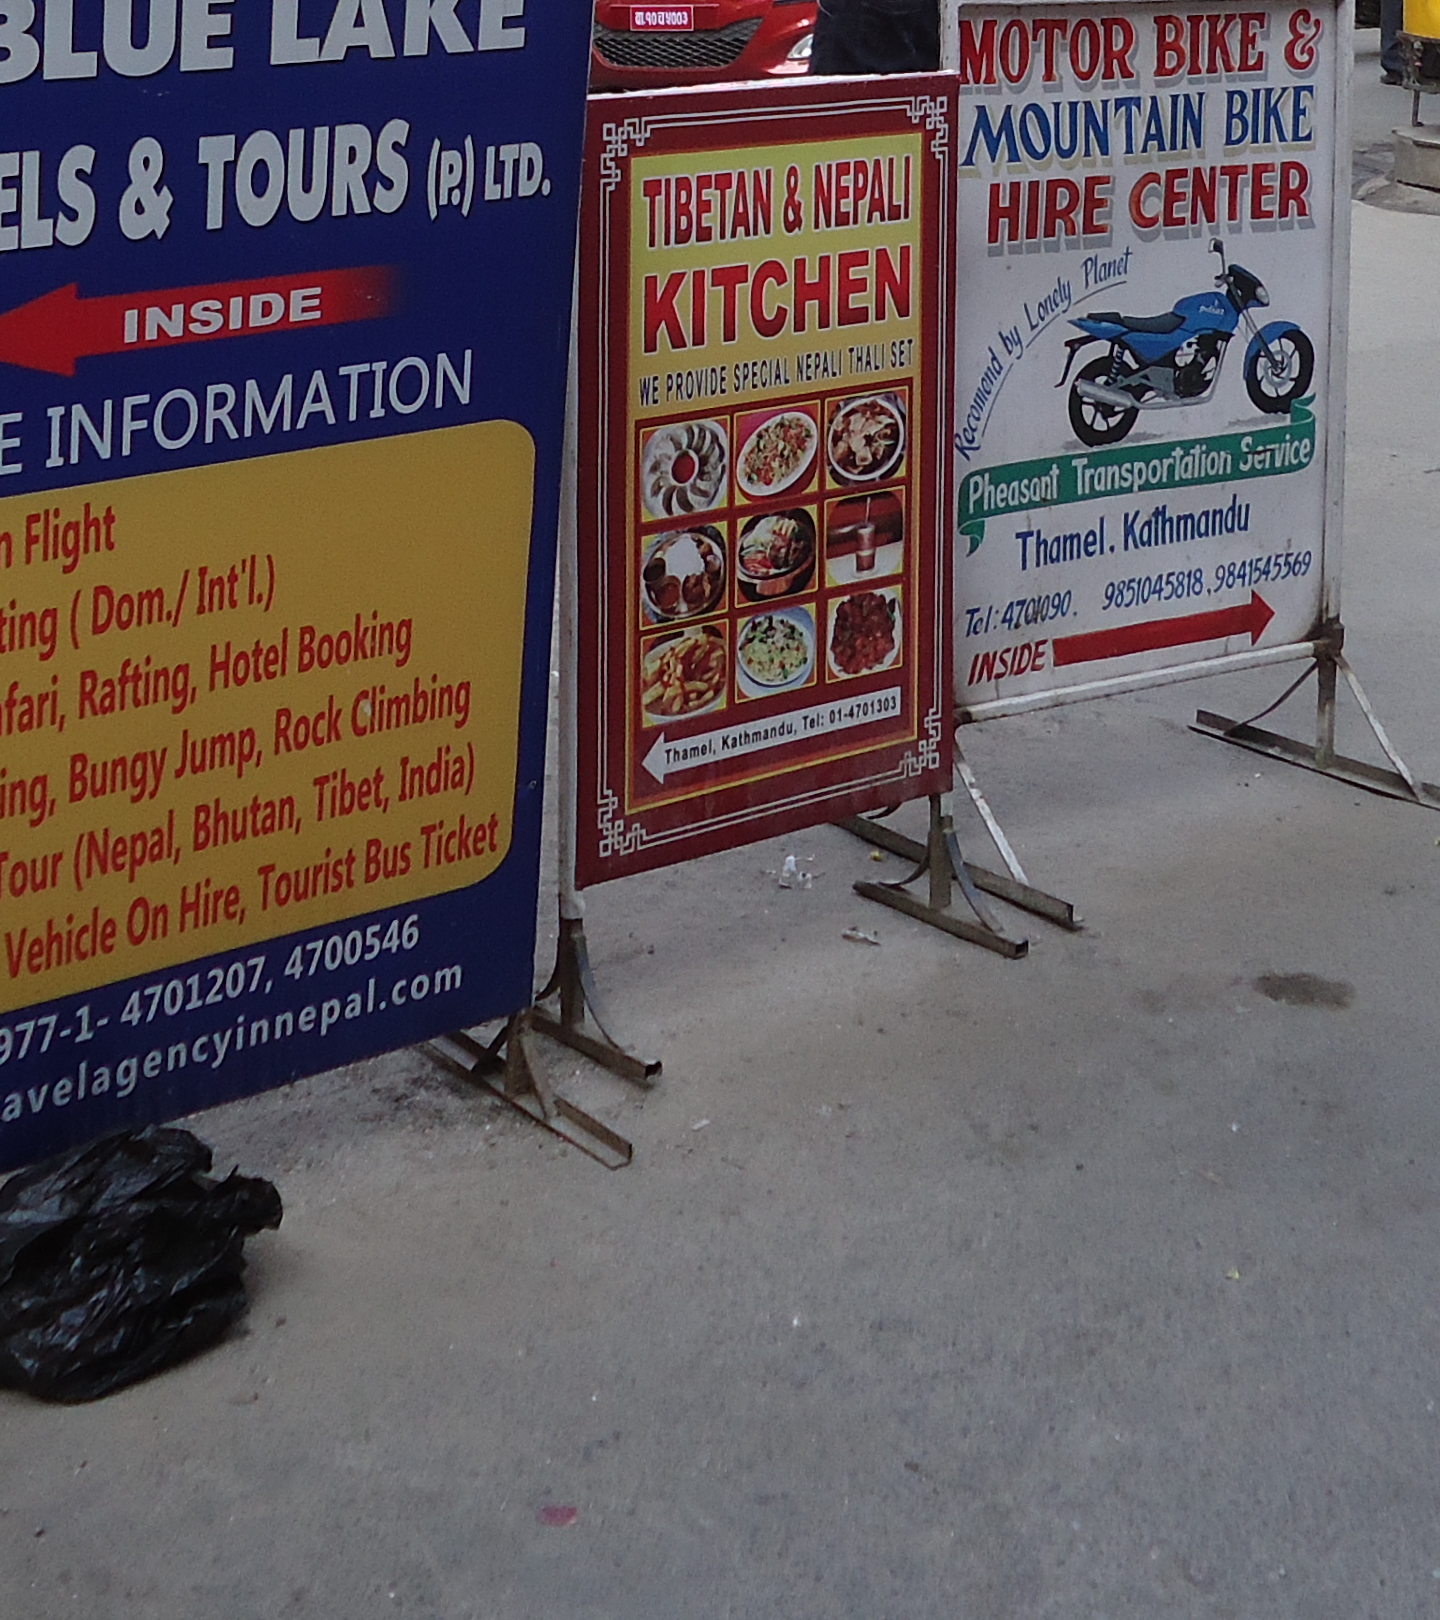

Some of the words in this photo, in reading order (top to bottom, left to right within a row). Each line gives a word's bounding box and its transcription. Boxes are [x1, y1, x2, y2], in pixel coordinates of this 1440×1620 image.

[960, 16, 1135, 85] MOTOR
[1153, 12, 1266, 77] BIKE
[1284, 8, 1323, 71] &
[959, 92, 1207, 167] MOUNTAIN
[1224, 85, 1315, 147] BIKE
[118, 135, 174, 241] &
[197, 118, 410, 231] TOURS
[484, 141, 551, 203] LTD.
[642, 167, 773, 250] TIBETAN
[782, 164, 803, 235] &
[813, 154, 912, 231] NEPALI
[988, 175, 1111, 245] HIRE
[1128, 161, 1309, 229] CENTER
[122, 285, 323, 345] INSIDE
[642, 244, 912, 355] KITCHEN
[998, 326, 1024, 360] by
[1023, 276, 1072, 331] Lonely
[1081, 246, 1133, 289] Planet
[46, 349, 474, 468] INFORMATION
[639, 375, 660, 407] WE
[666, 365, 727, 402] PROVIDE
[733, 356, 791, 392] SPECIAL
[796, 347, 843, 380] NEPALI
[848, 343, 885, 373] THALI
[890, 338, 914, 368] SET
[968, 465, 1060, 515] Pheasant
[1071, 446, 1232, 492] Transportation
[1239, 433, 1312, 472] Service
[24, 503, 116, 574] Flight
[1123, 493, 1251, 552] Kathmandu
[77, 654, 197, 723] Rafting,
[208, 627, 289, 692] Hotel
[297, 610, 414, 676] Booking
[968, 638, 1048, 686] INSIDE
[68, 744, 167, 807] Bungy
[174, 717, 262, 780] Jump,
[274, 696, 342, 759] Rock
[350, 672, 472, 738] Climbing
[665, 738, 717, 765] Thamel,
[721, 720, 798, 751] Kathmandu,
[802, 712, 826, 731] Tel:
[828, 695, 898, 726] 01-4701303
[72, 813, 182, 895] (Nepal,
[191, 788, 303, 853] Bhutan,
[313, 764, 392, 826] Tibet,
[397, 742, 475, 798] India)
[3, 905, 117, 979] Vehicle
[125, 897, 169, 949] On
[177, 875, 247, 934] Hire,
[257, 847, 356, 915] Tourist
[363, 831, 411, 885] Bus
[420, 811, 500, 870] Ticket
[120, 955, 274, 1026] 4701207,
[282, 914, 420, 980] 4700546
